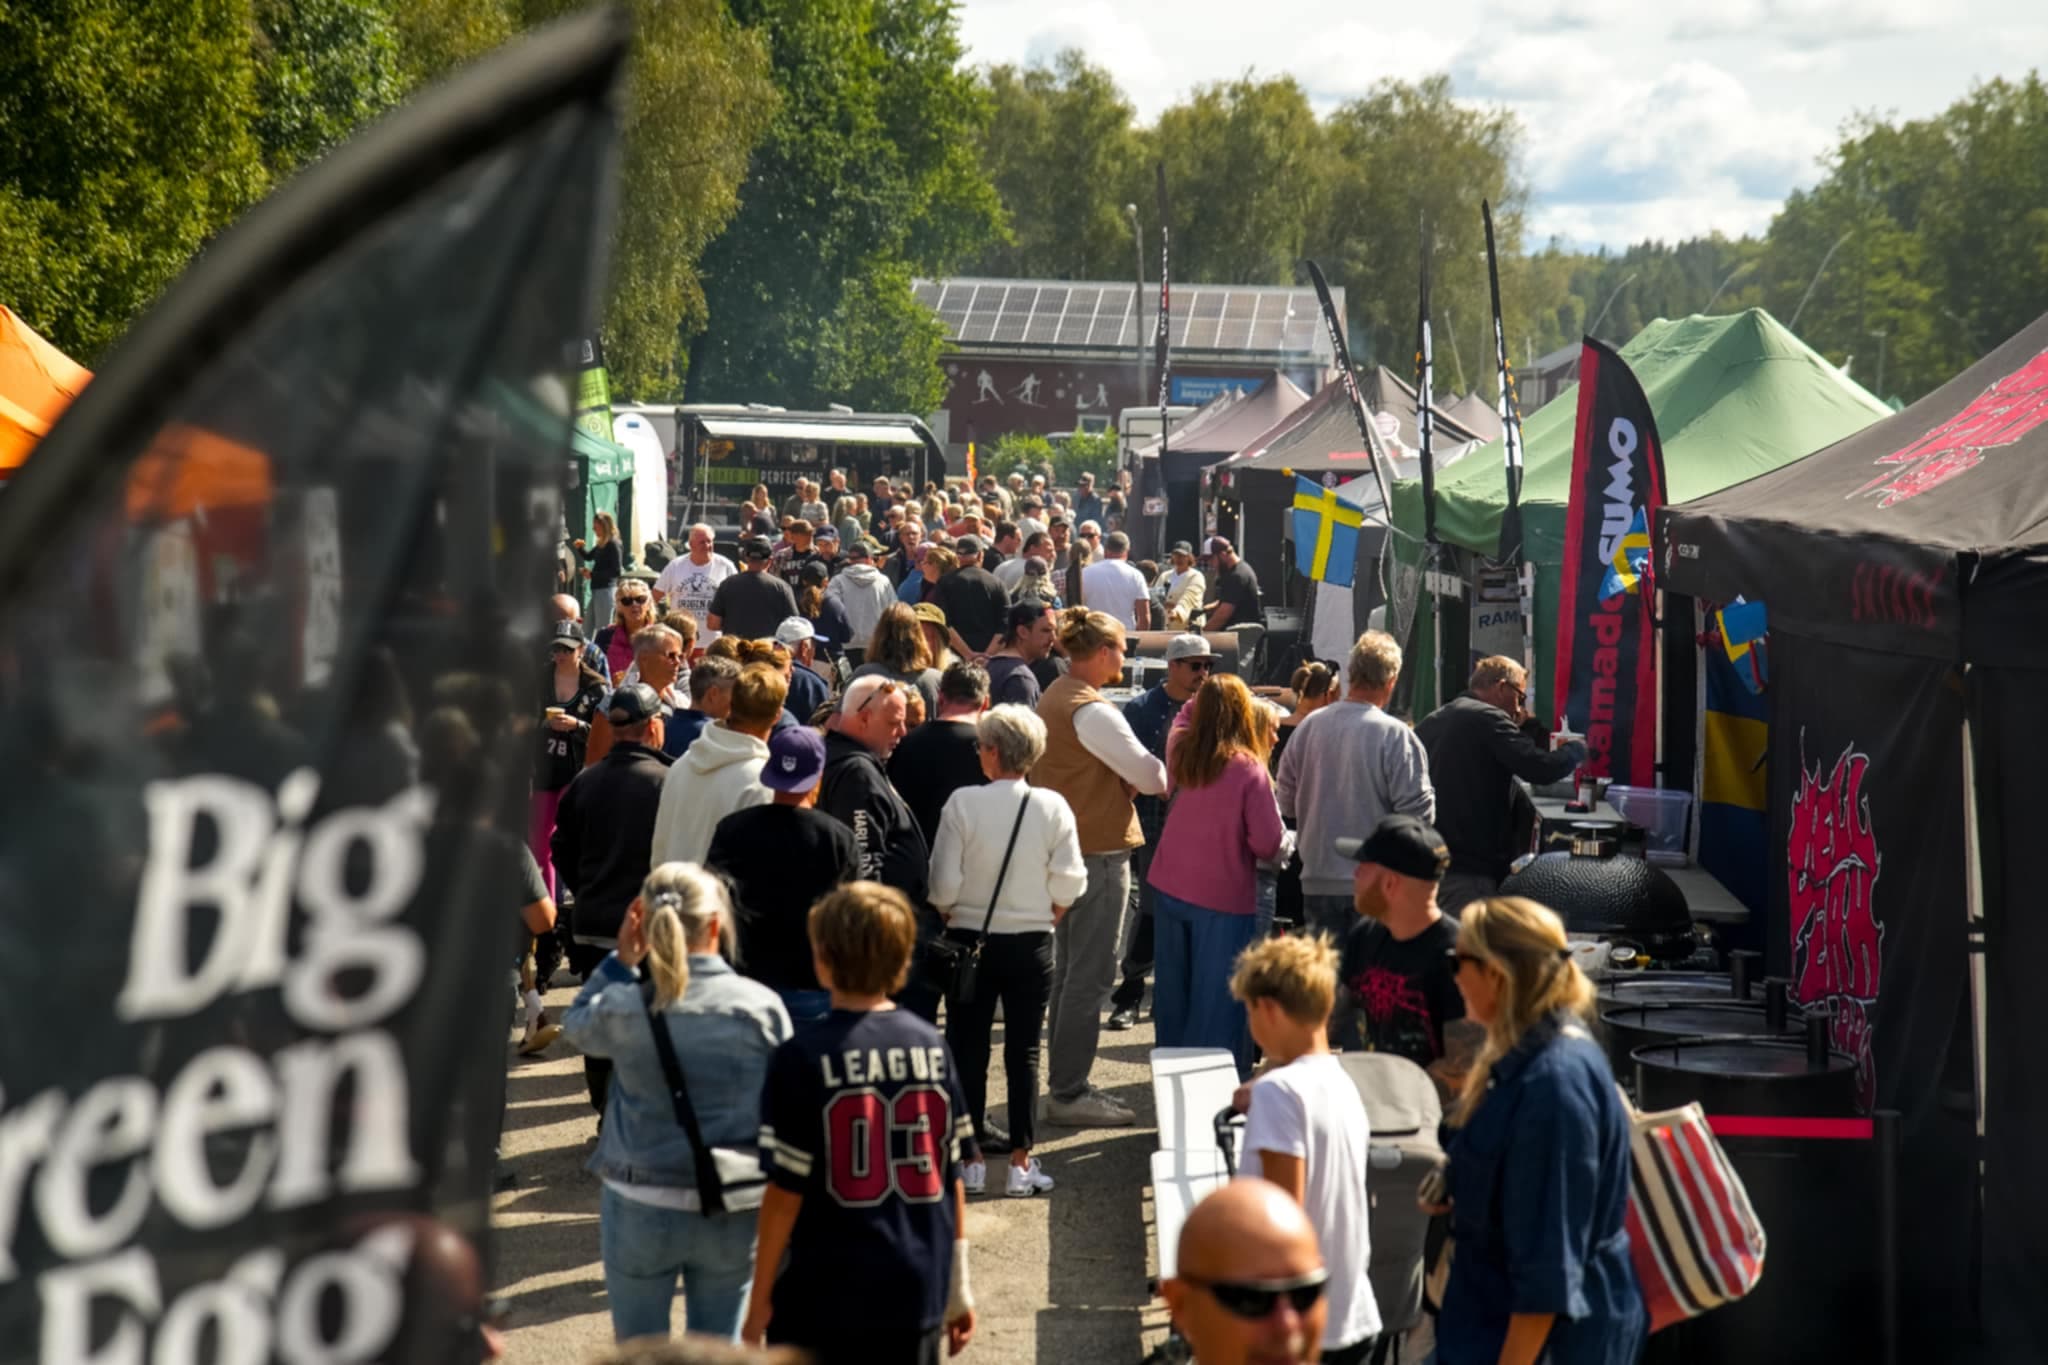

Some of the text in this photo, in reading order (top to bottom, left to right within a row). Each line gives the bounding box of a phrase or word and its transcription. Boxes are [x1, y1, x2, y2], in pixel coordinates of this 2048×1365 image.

[1598, 417, 1638, 566] SUMO
[115, 767, 437, 1031] Big
[821, 1046, 947, 1088] LEAGUE
[822, 1082, 952, 1208] 03
